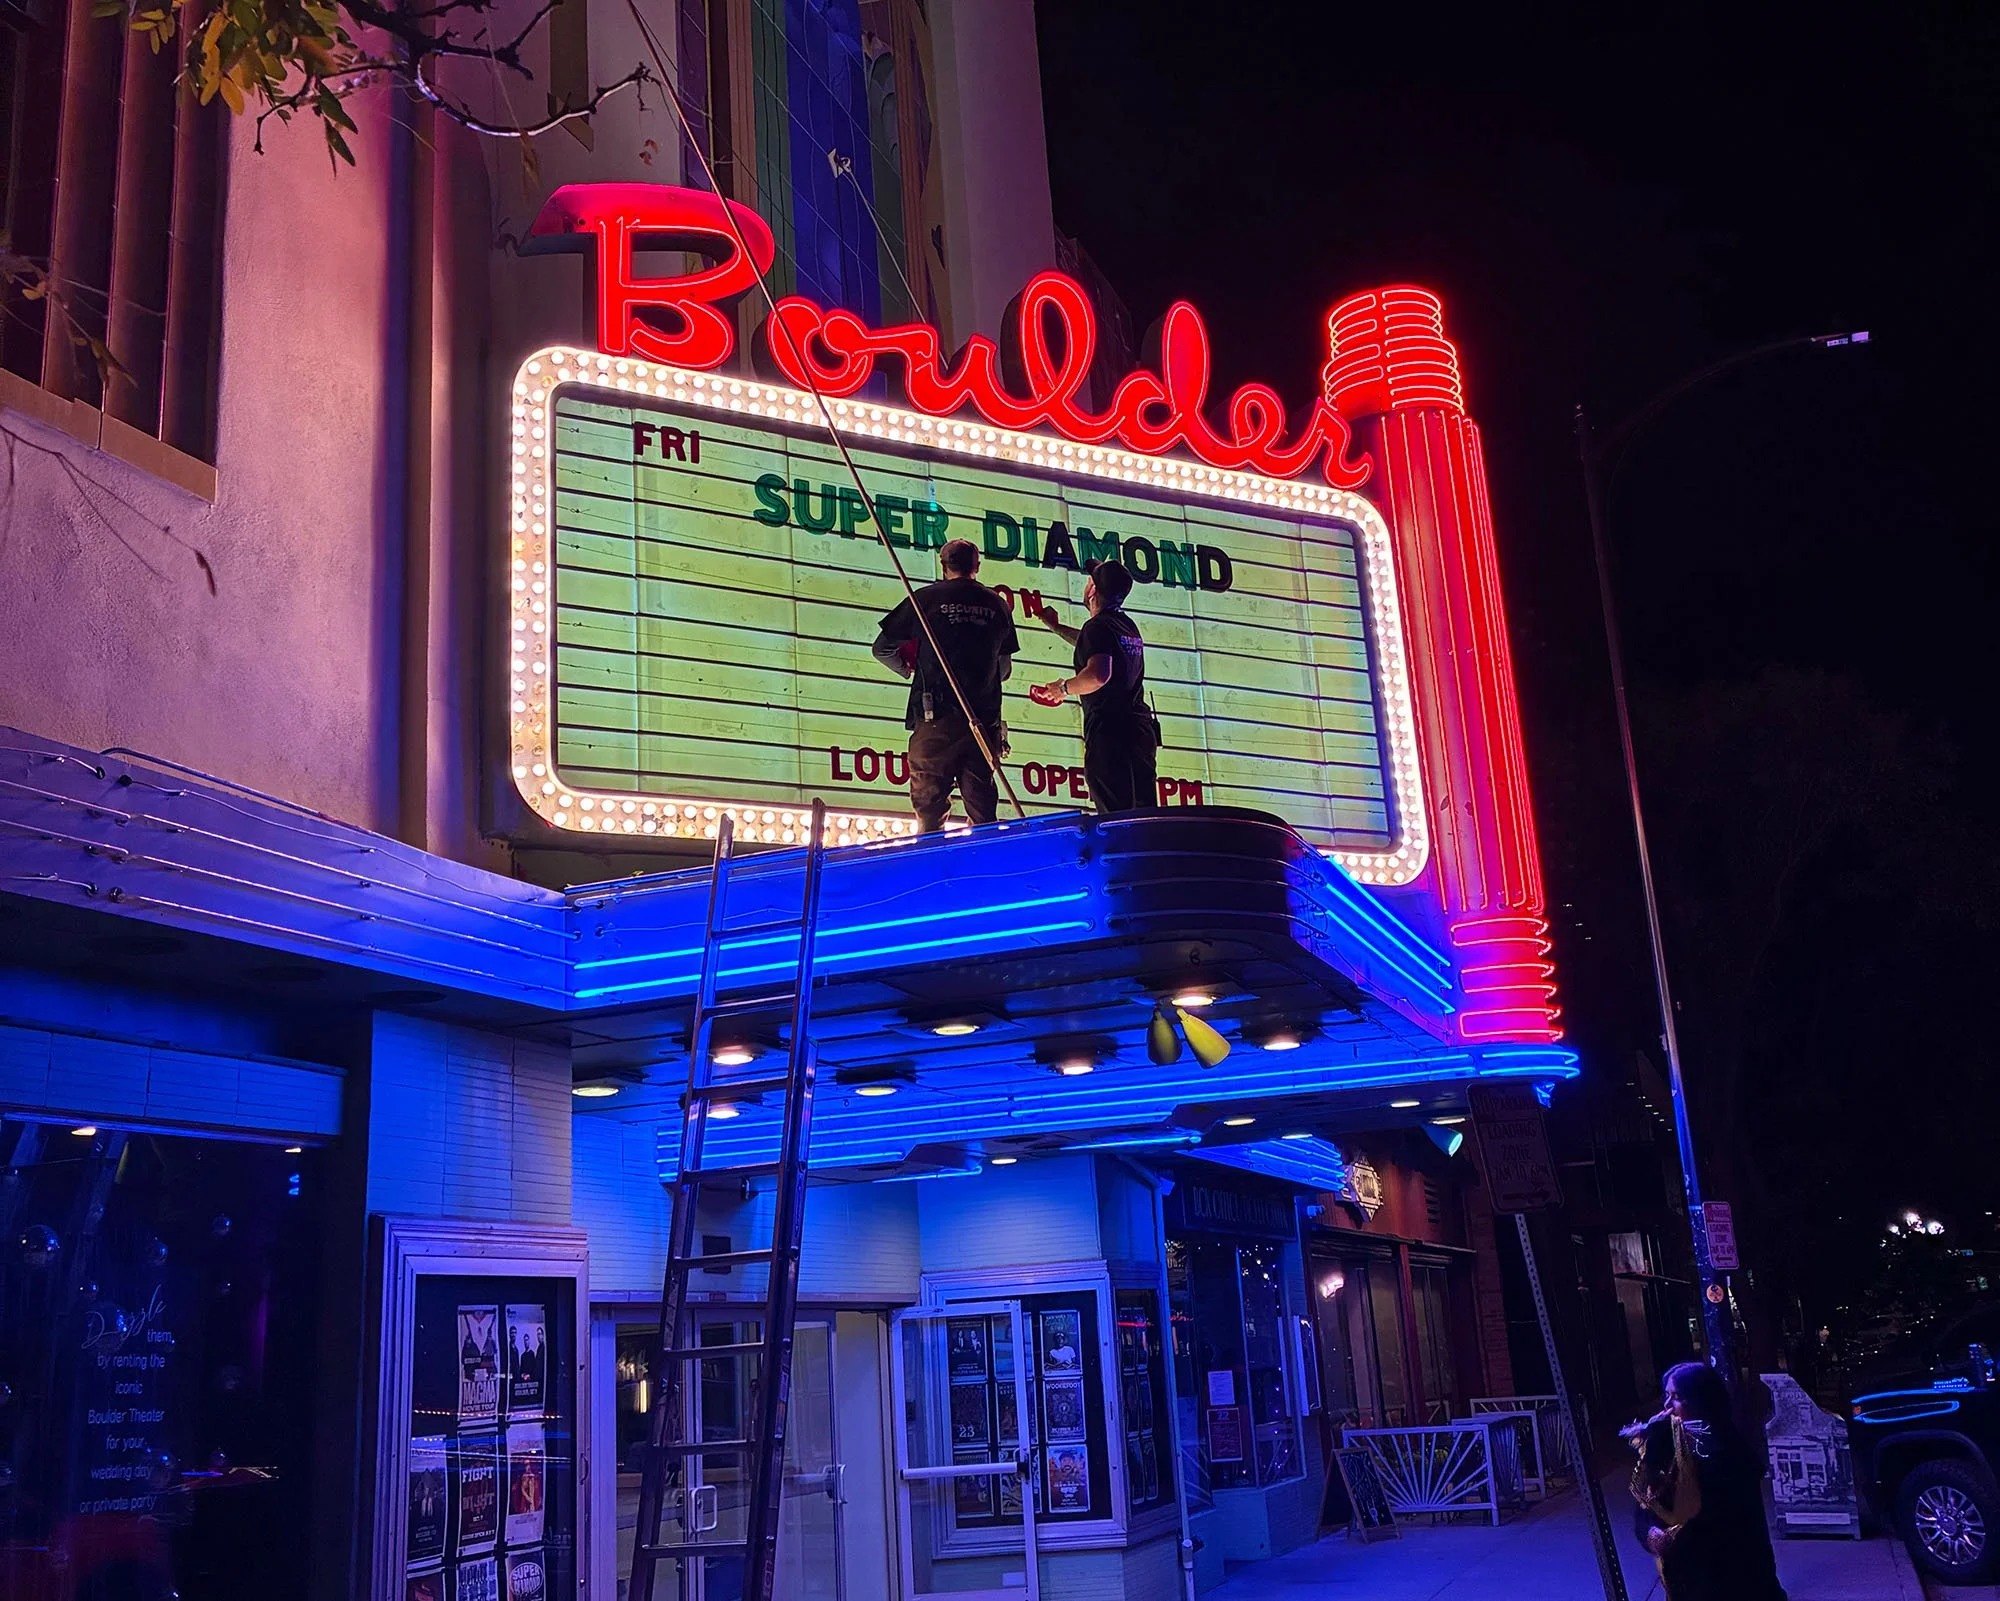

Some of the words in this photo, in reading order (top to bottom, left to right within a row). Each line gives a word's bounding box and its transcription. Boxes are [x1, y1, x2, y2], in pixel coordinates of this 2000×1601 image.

[532, 183, 1373, 489] Boulder
[633, 422, 700, 464] FRI
[753, 473, 950, 552] SUPER
[982, 510, 1234, 593] DIAMOND
[940, 603, 996, 619] SECURITY
[830, 746, 910, 786] LOU
[1022, 762, 1093, 801] OPE
[1487, 1121, 1538, 1140] LOADING
[1500, 1143, 1532, 1161] ZONE
[81, 1283, 167, 1349] Dzzle
[97, 1353, 111, 1370] by
[112, 1354, 147, 1370] renting
[149, 1352, 166, 1368] the
[115, 1380, 144, 1395] iconic
[463, 1380, 496, 1405] MAGMA
[87, 1408, 127, 1424] Boulder
[128, 1408, 165, 1423] Theater
[959, 1424, 975, 1438] 23
[106, 1435, 120, 1450] for
[90, 1464, 132, 1481] wedding
[134, 1464, 152, 1481] day
[462, 1466, 494, 1484] FIGHT
[80, 1502, 91, 1514] or
[92, 1497, 129, 1516] private
[130, 1495, 157, 1514] party
[512, 1565, 541, 1580] SUPER
